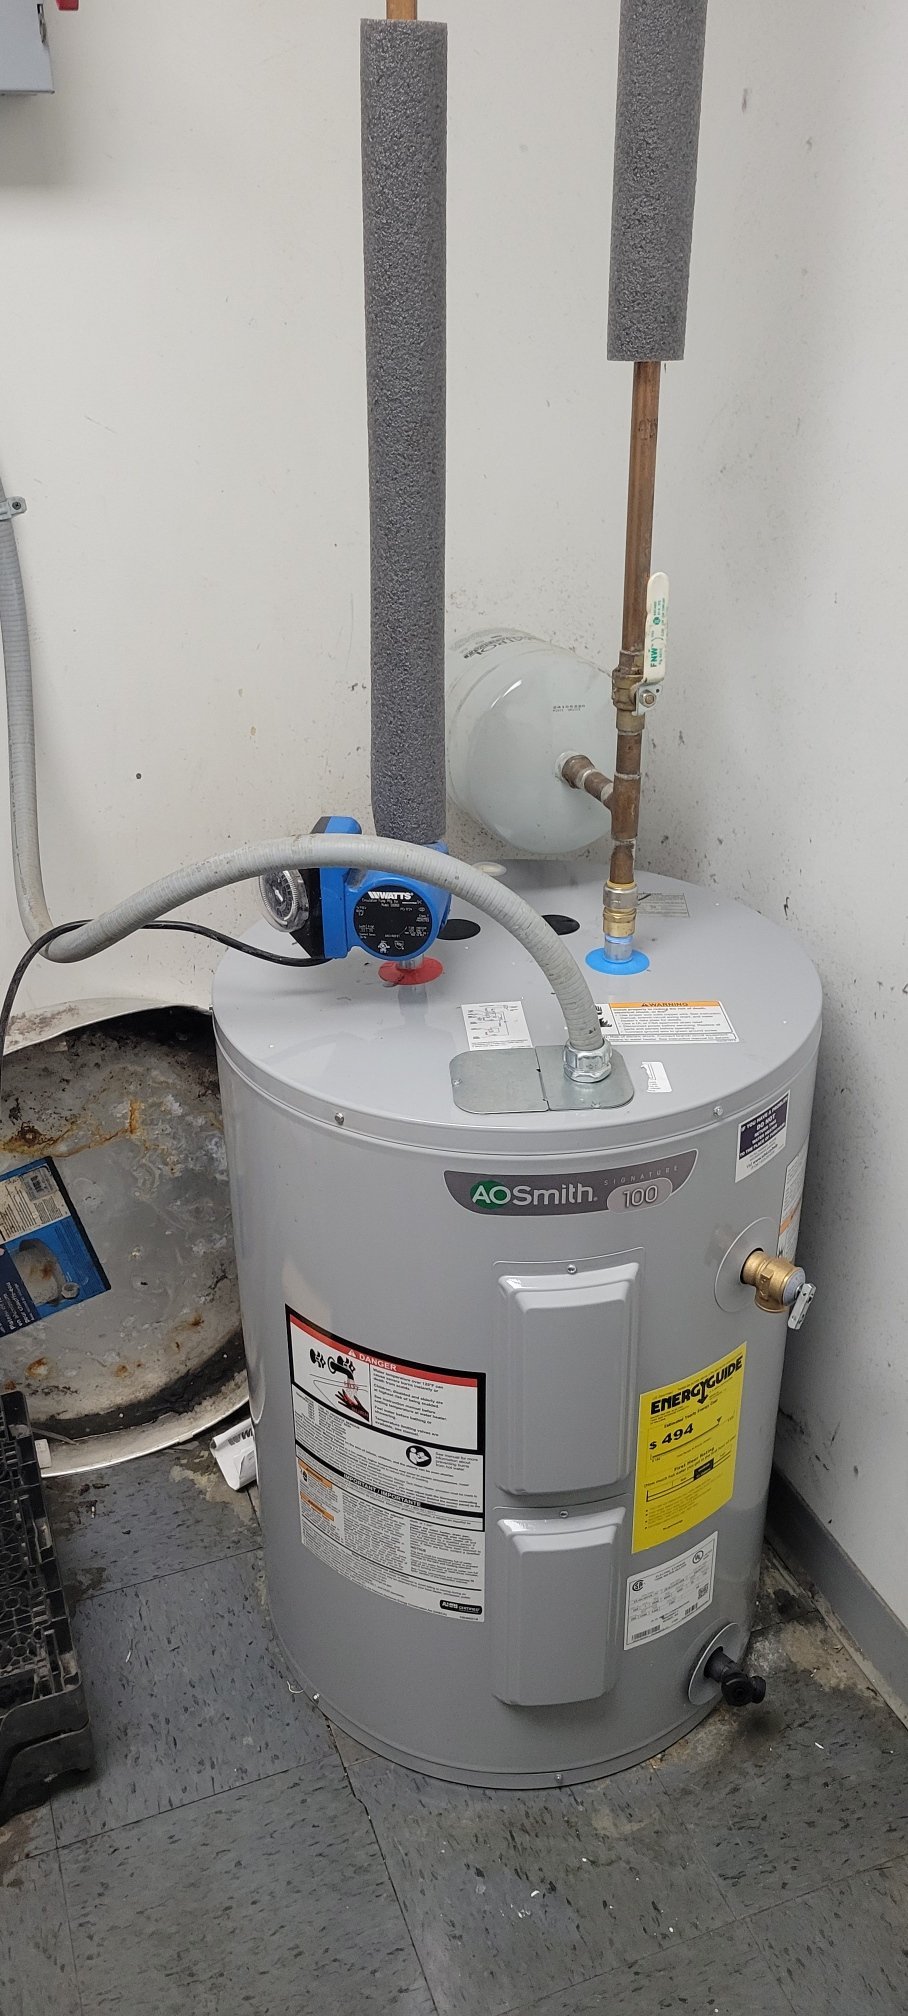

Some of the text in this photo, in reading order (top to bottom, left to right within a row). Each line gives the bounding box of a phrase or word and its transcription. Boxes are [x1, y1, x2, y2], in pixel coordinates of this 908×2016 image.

[650, 647, 658, 667] FNW
[368, 891, 412, 900] WATTS
[756, 1113, 776, 1131] DO NOT
[604, 1165, 679, 1186] SIGNATURE
[623, 1184, 659, 1208] 100
[359, 1353, 397, 1372] DANGER
[650, 1355, 743, 1415] ENERGYGUIDE
[661, 1423, 694, 1444] 494
[343, 1473, 377, 1492] IMPORTANT
[380, 1489, 421, 1507] IMPORTANTE
